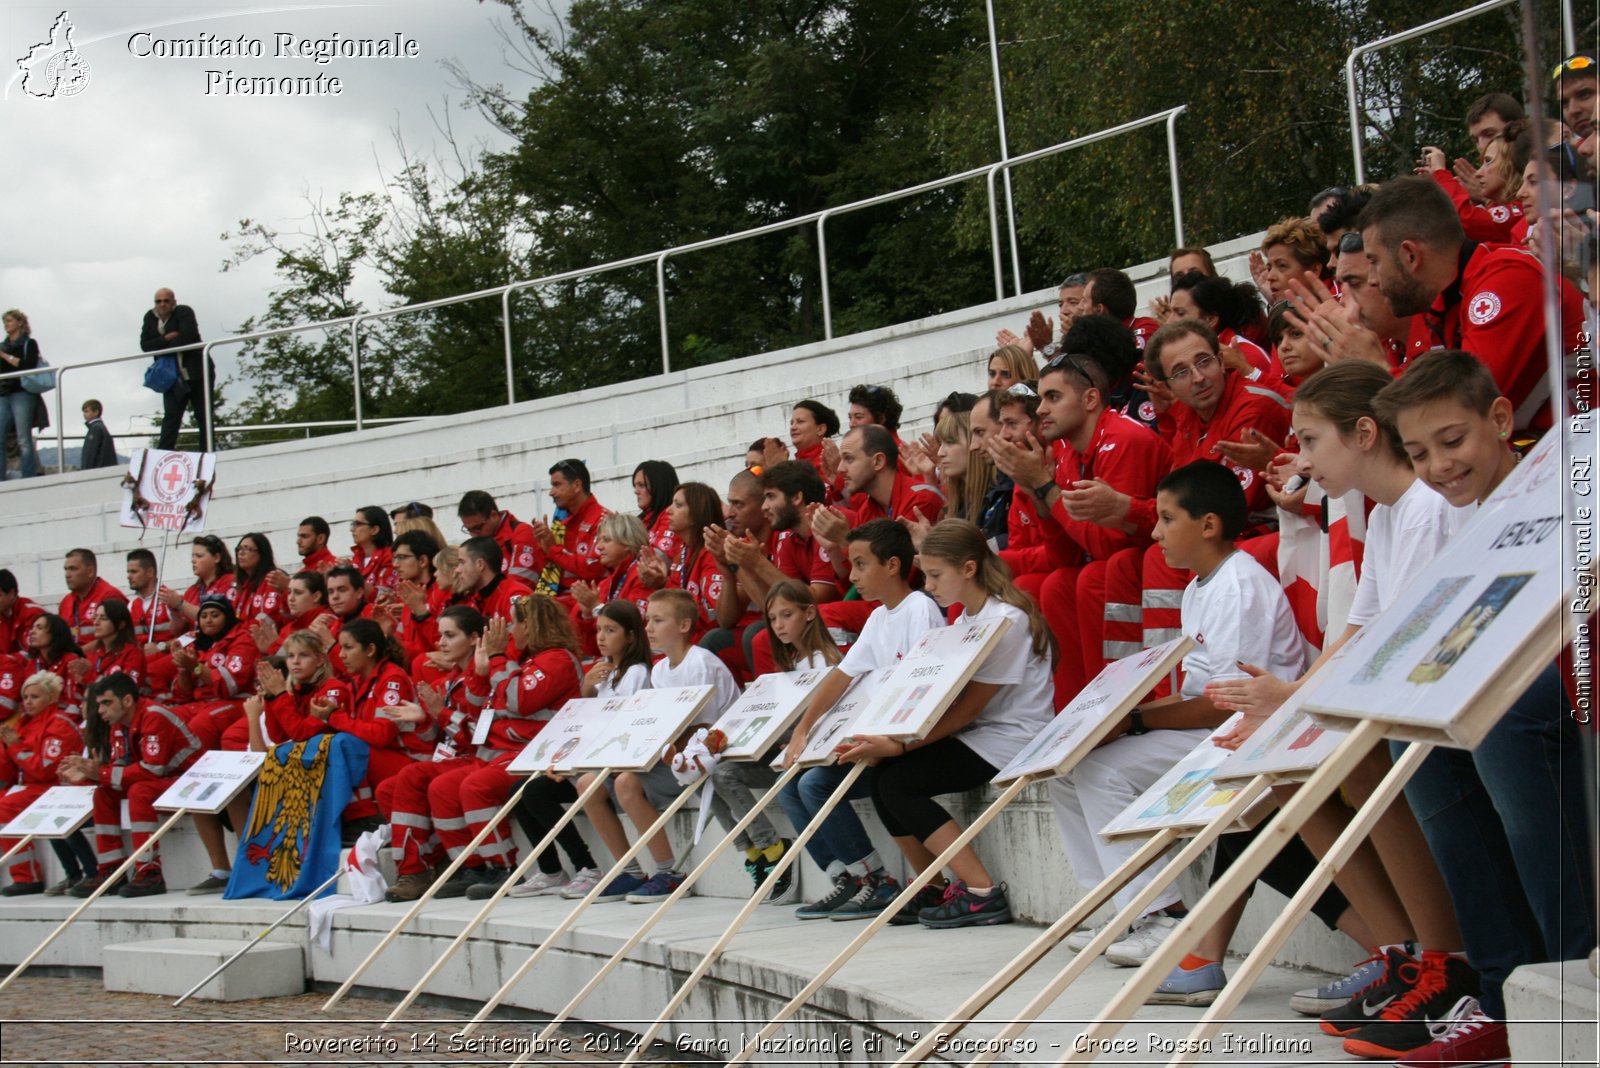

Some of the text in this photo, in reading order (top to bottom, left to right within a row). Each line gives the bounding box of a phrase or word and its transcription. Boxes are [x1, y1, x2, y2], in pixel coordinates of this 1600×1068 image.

[1488, 514, 1563, 551] VENETO
[906, 664, 944, 680] PIEMONTE
[742, 702, 779, 713] LOMBARDIA
[630, 717, 658, 727] LIGURIA
[563, 725, 583, 733] LAZIO
